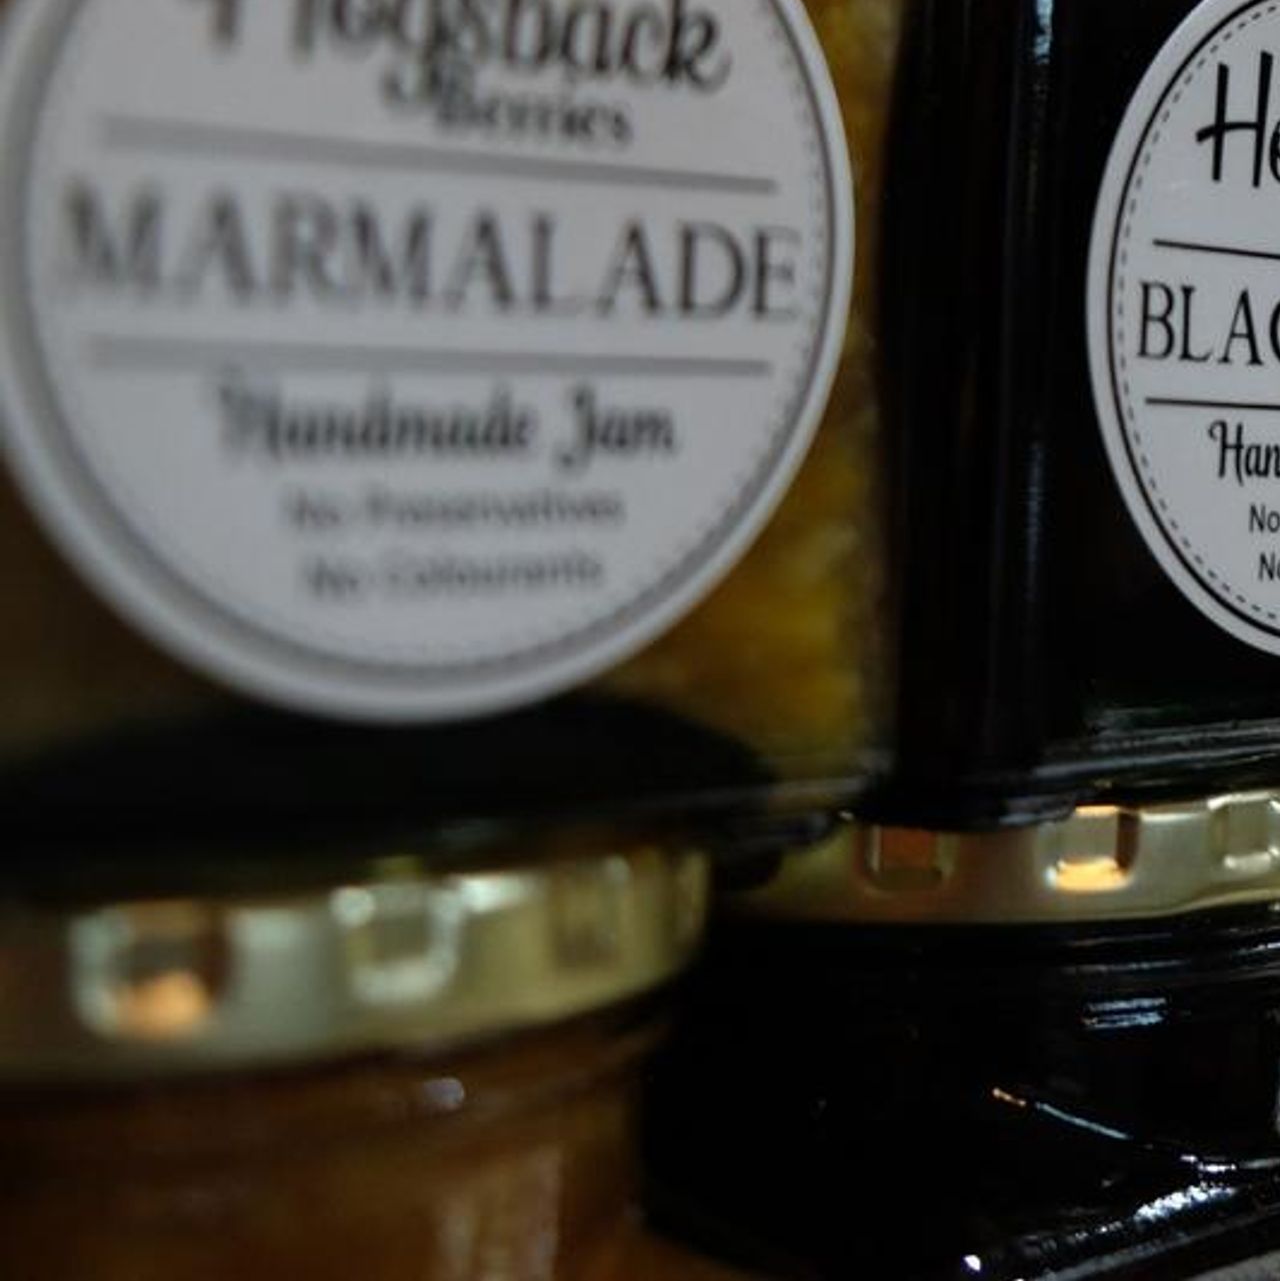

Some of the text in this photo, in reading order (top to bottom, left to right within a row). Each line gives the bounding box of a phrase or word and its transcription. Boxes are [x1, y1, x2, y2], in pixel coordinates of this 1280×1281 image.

[432, 60, 636, 146] Berries
[60, 175, 802, 323] MARMALADE
[213, 365, 679, 474] Handmade Jam
